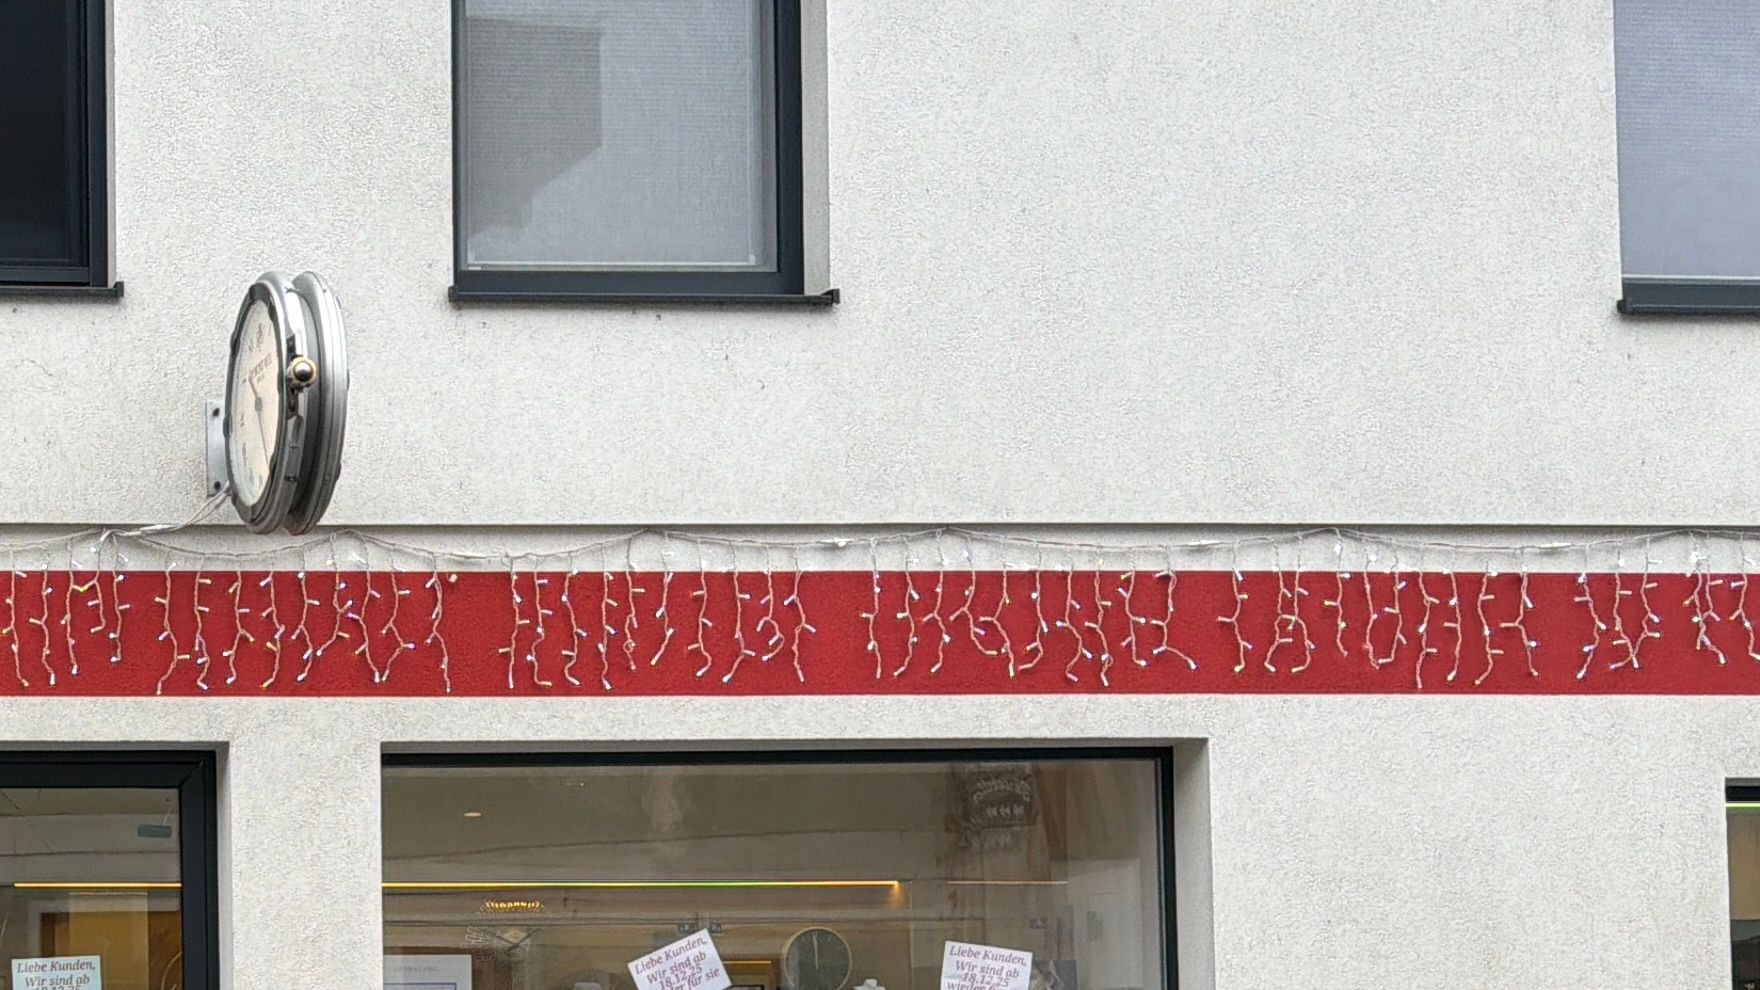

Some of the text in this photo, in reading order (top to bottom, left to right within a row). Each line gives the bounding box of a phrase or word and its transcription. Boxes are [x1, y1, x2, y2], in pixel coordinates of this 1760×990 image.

[950, 945, 980, 959] Liebe
[17, 962, 47, 973] Liebe
[635, 956, 663, 975] Liebe
[647, 951, 706, 984] Wir sind ab
[956, 960, 1019, 978] Wir sind ab
[25, 974, 90, 986] Wir sind ab
[705, 969, 720, 980] sie
